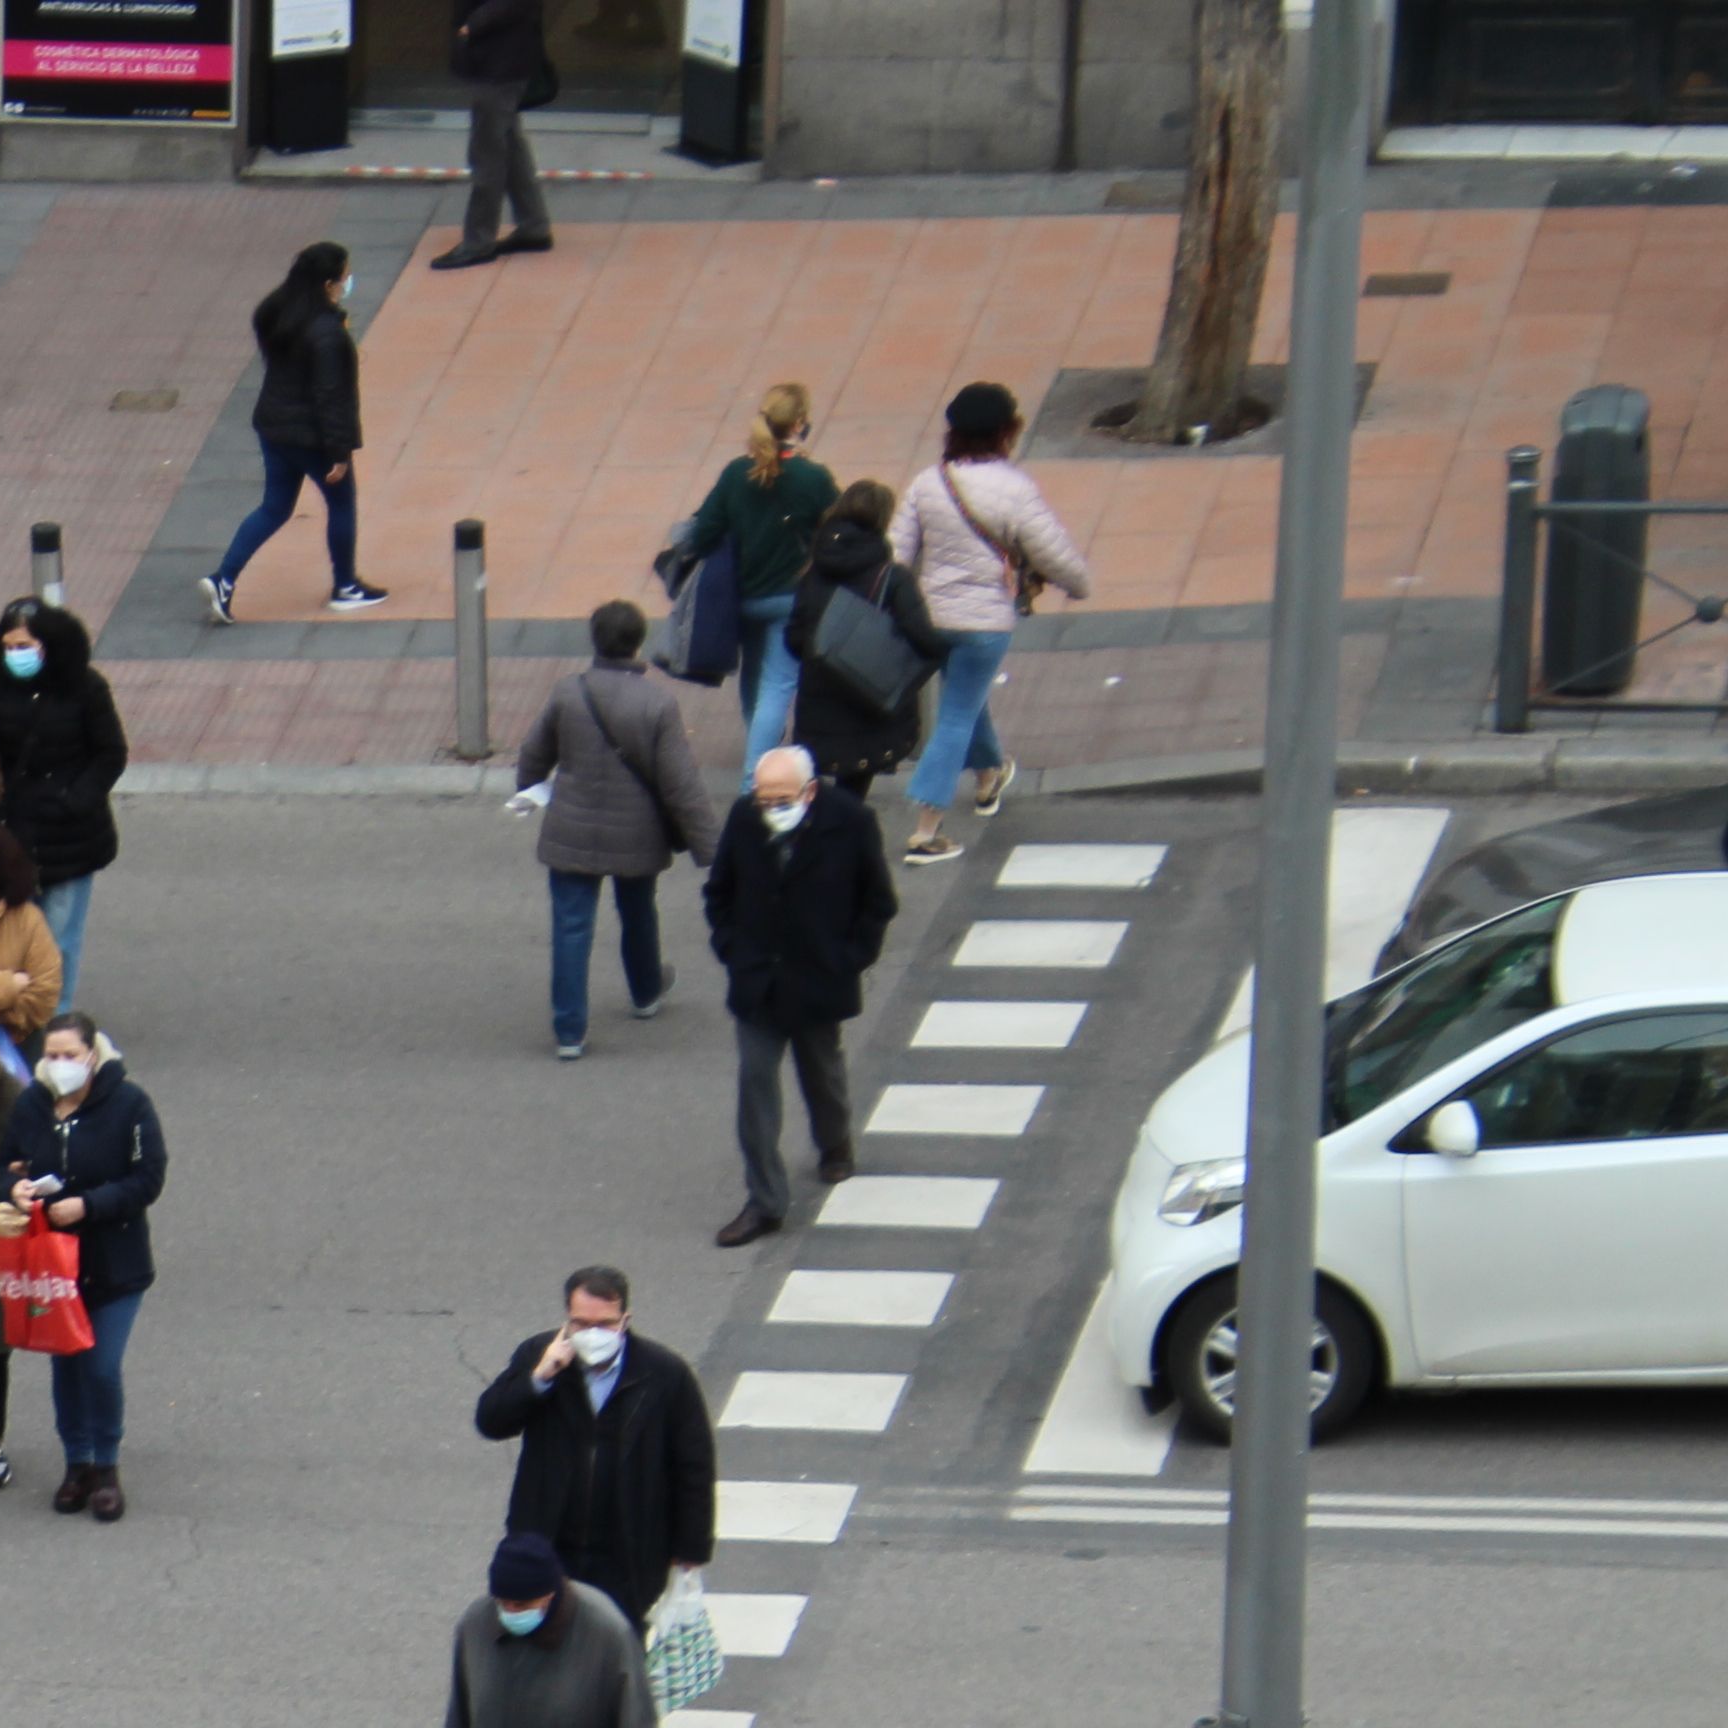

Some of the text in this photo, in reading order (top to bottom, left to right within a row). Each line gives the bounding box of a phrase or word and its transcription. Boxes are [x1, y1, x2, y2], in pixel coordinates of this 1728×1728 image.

[34, 45, 199, 60] COSMÉTICA DERMATOLÓGICA
[37, 61, 197, 75] AL SERVICIO DE LA BELLEZA
